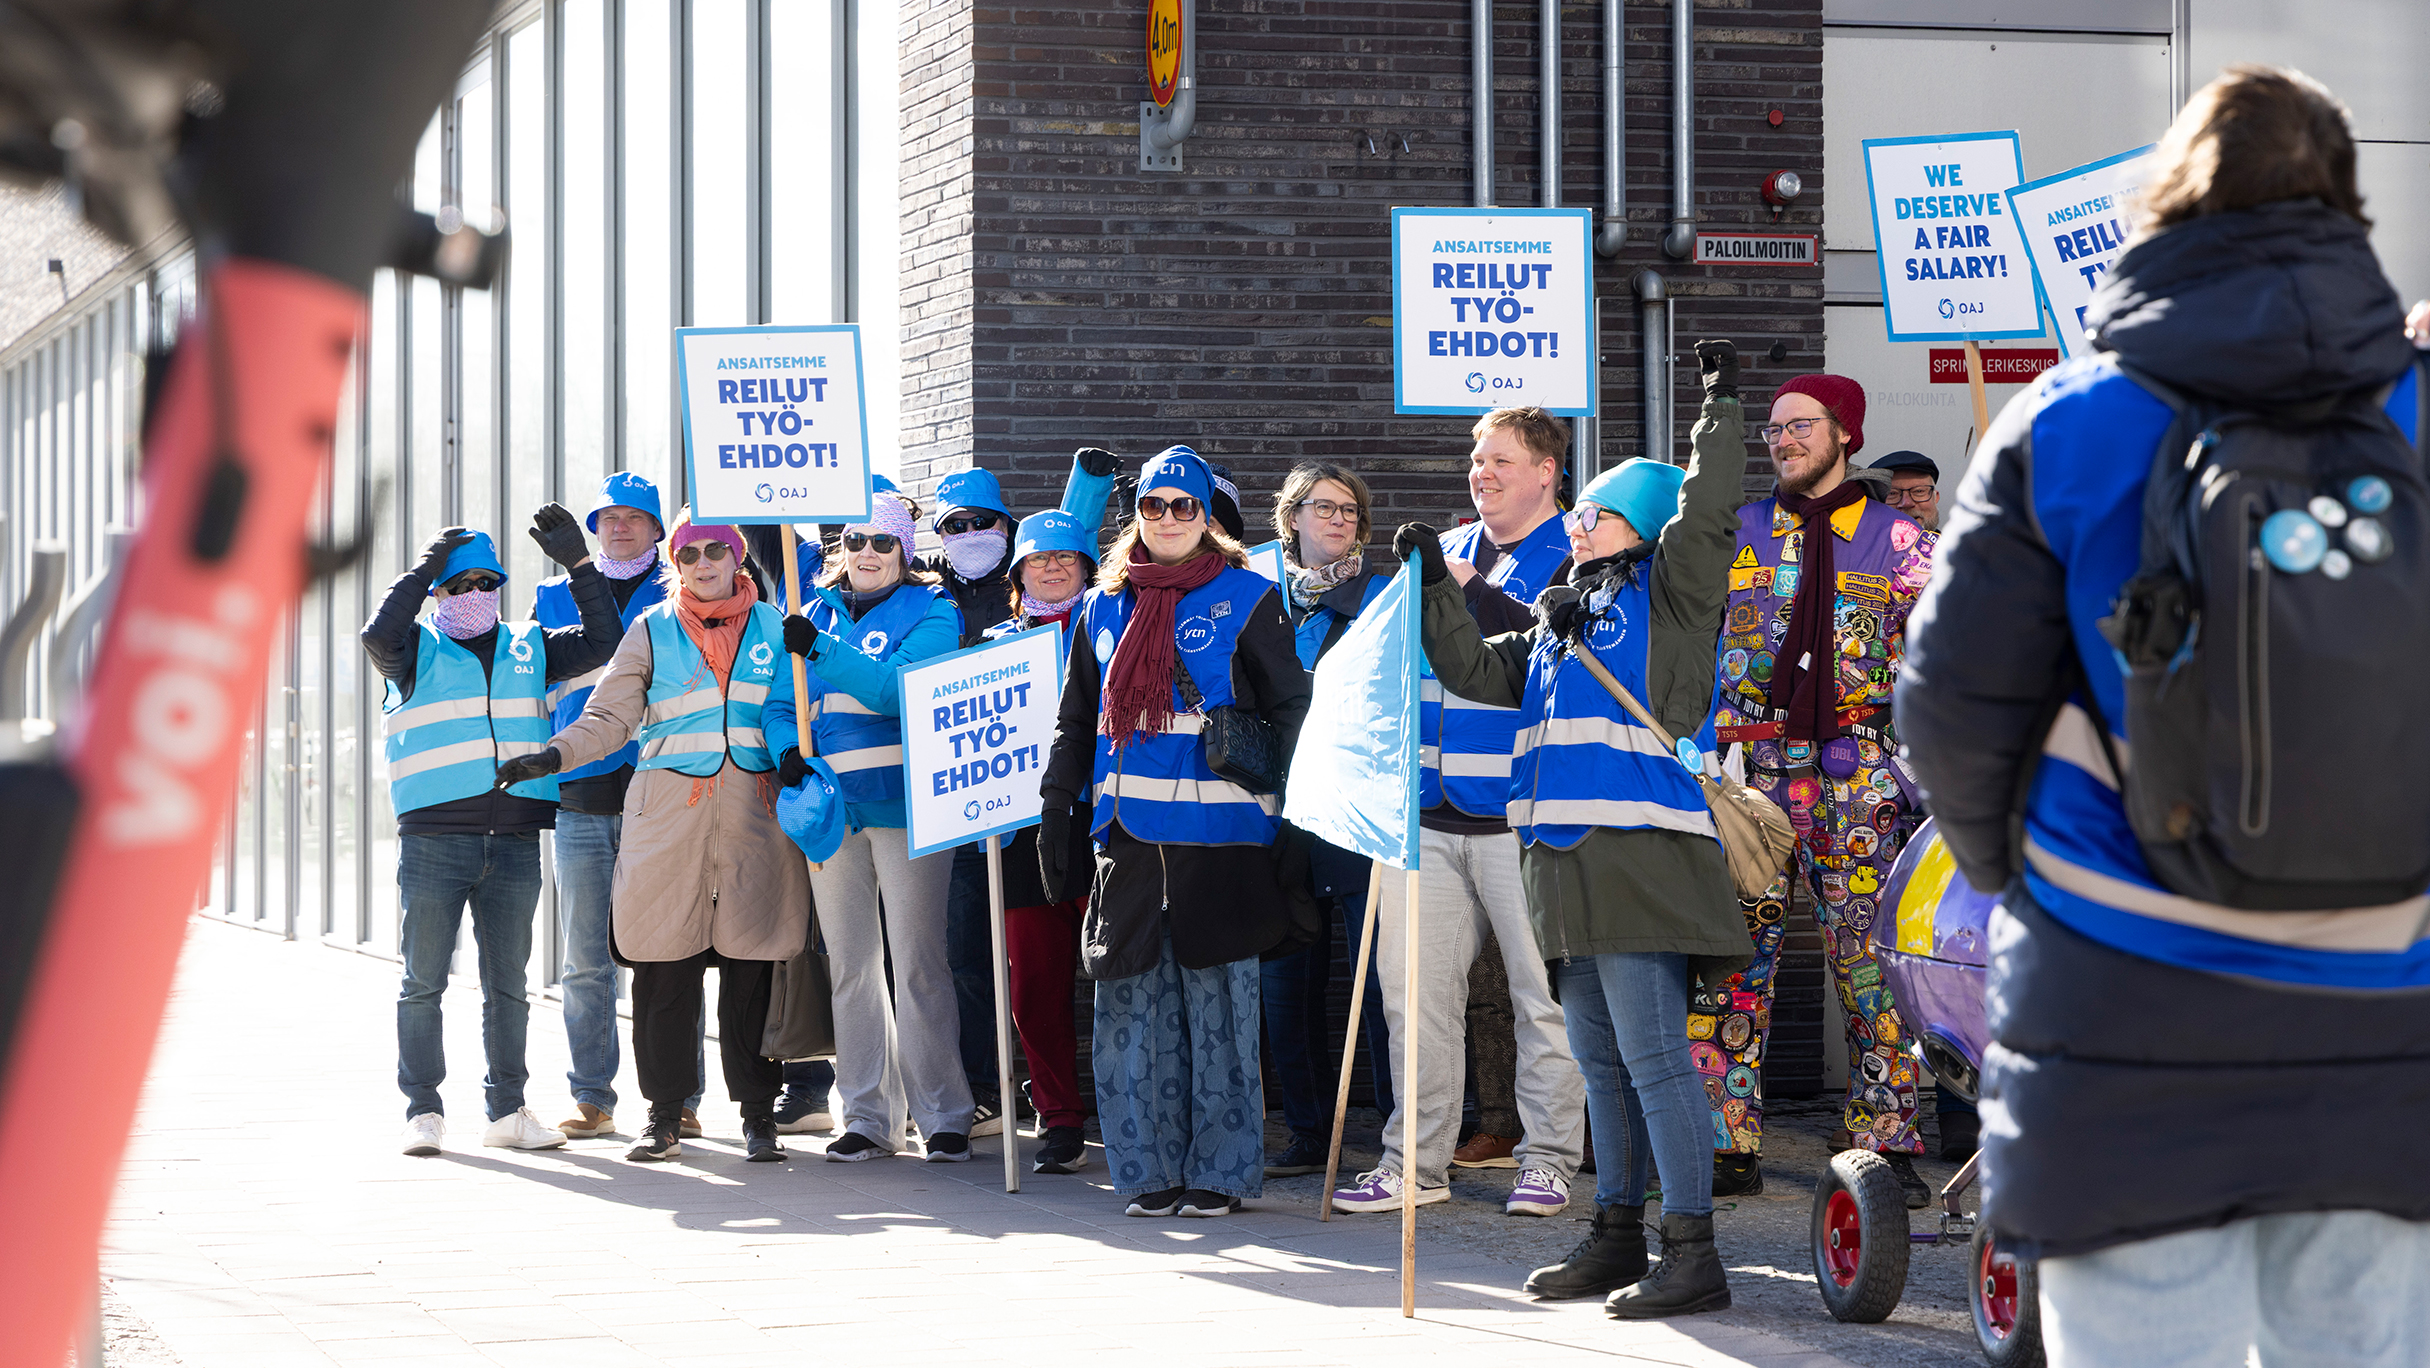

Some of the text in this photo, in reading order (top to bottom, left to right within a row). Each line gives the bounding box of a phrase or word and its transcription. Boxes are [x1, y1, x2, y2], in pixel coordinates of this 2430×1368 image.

[1923, 164, 1963, 188] WE
[1894, 193, 2002, 220] DESERVE
[2047, 186, 2139, 227] ANSAITSE
[1914, 225, 1991, 250] A FAIR
[2053, 213, 2137, 263] REILU
[1432, 240, 1552, 254] ANSAITSEMME
[1705, 240, 1806, 259] PALOILMOITIN
[1905, 254, 2008, 281] SALARY!
[1432, 263, 1552, 289] REILUT
[1451, 290, 1534, 324] TYÖ-
[1959, 302, 1984, 314] OAJ
[1429, 331, 1558, 358] EHDOT!
[717, 356, 826, 370] ANSAITSEMME
[1933, 359, 2055, 373] SPRINLERIKESKUS
[718, 378, 828, 404] REILUT
[1492, 378, 1523, 389] OAJ
[1878, 391, 1956, 406] PALOKUNTA
[737, 404, 813, 436] TYÖ-
[718, 443, 838, 469] EHDOT!
[1160, 461, 1185, 477] tn
[634, 482, 648, 491] OAJ
[952, 480, 965, 489] OAJ
[780, 488, 807, 498] OAJ
[1847, 574, 1877, 584] HALLITUS
[1846, 583, 1876, 594] HALLITUS
[1184, 629, 1206, 640] ytn
[514, 665, 534, 674] OAJ
[752, 667, 773, 676] OAJ
[932, 661, 1030, 700] ANSAITSEMME
[933, 681, 1031, 733] REILUT
[1861, 708, 1875, 717] TSTS
[949, 715, 1017, 759] TYÖ-
[1722, 730, 1738, 738] TSTS
[1866, 727, 1877, 740] RY
[932, 743, 1039, 797] EHDOT!
[1824, 778, 1835, 811] TRADE
[986, 795, 1011, 811] OAJ
